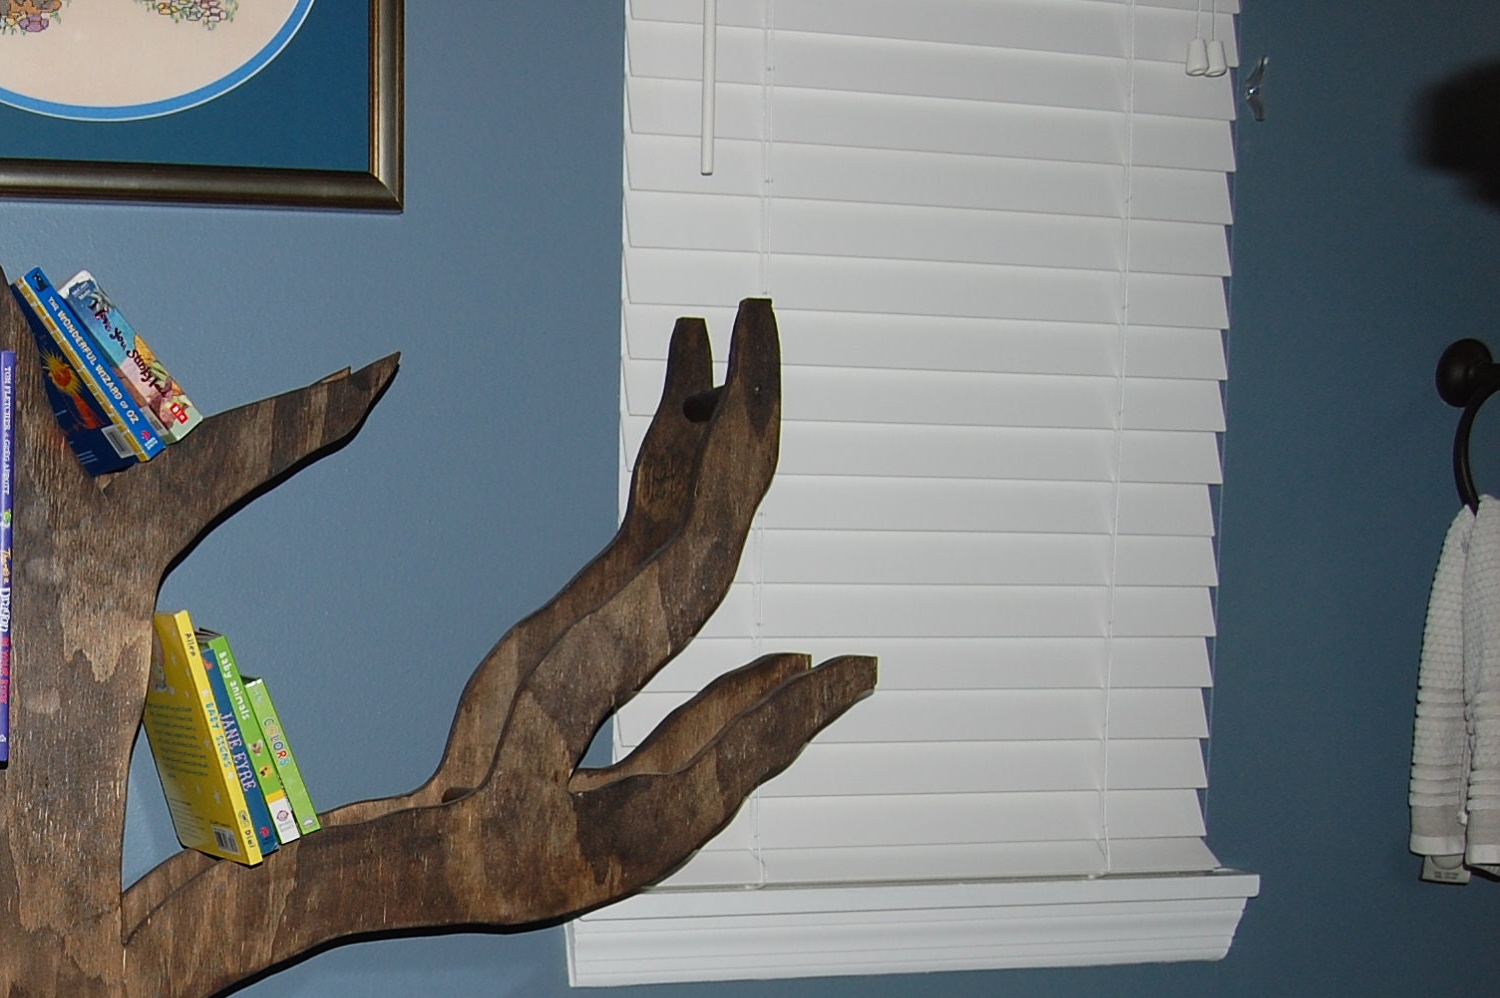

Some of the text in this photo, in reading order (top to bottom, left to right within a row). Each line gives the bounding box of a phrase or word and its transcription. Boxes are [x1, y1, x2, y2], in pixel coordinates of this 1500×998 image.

[3, 365, 11, 384] TOM
[55, 308, 100, 365] WONDERFUL
[93, 362, 124, 401] WIZARD
[125, 407, 140, 424] OZ
[3, 385, 11, 431] FLETCHER
[215, 650, 251, 721] Baby animals
[204, 701, 232, 769] BABY SIGNS
[217, 710, 256, 793] JANE EYRE
[262, 716, 292, 768] COLORS
[243, 828, 255, 849] Dial
